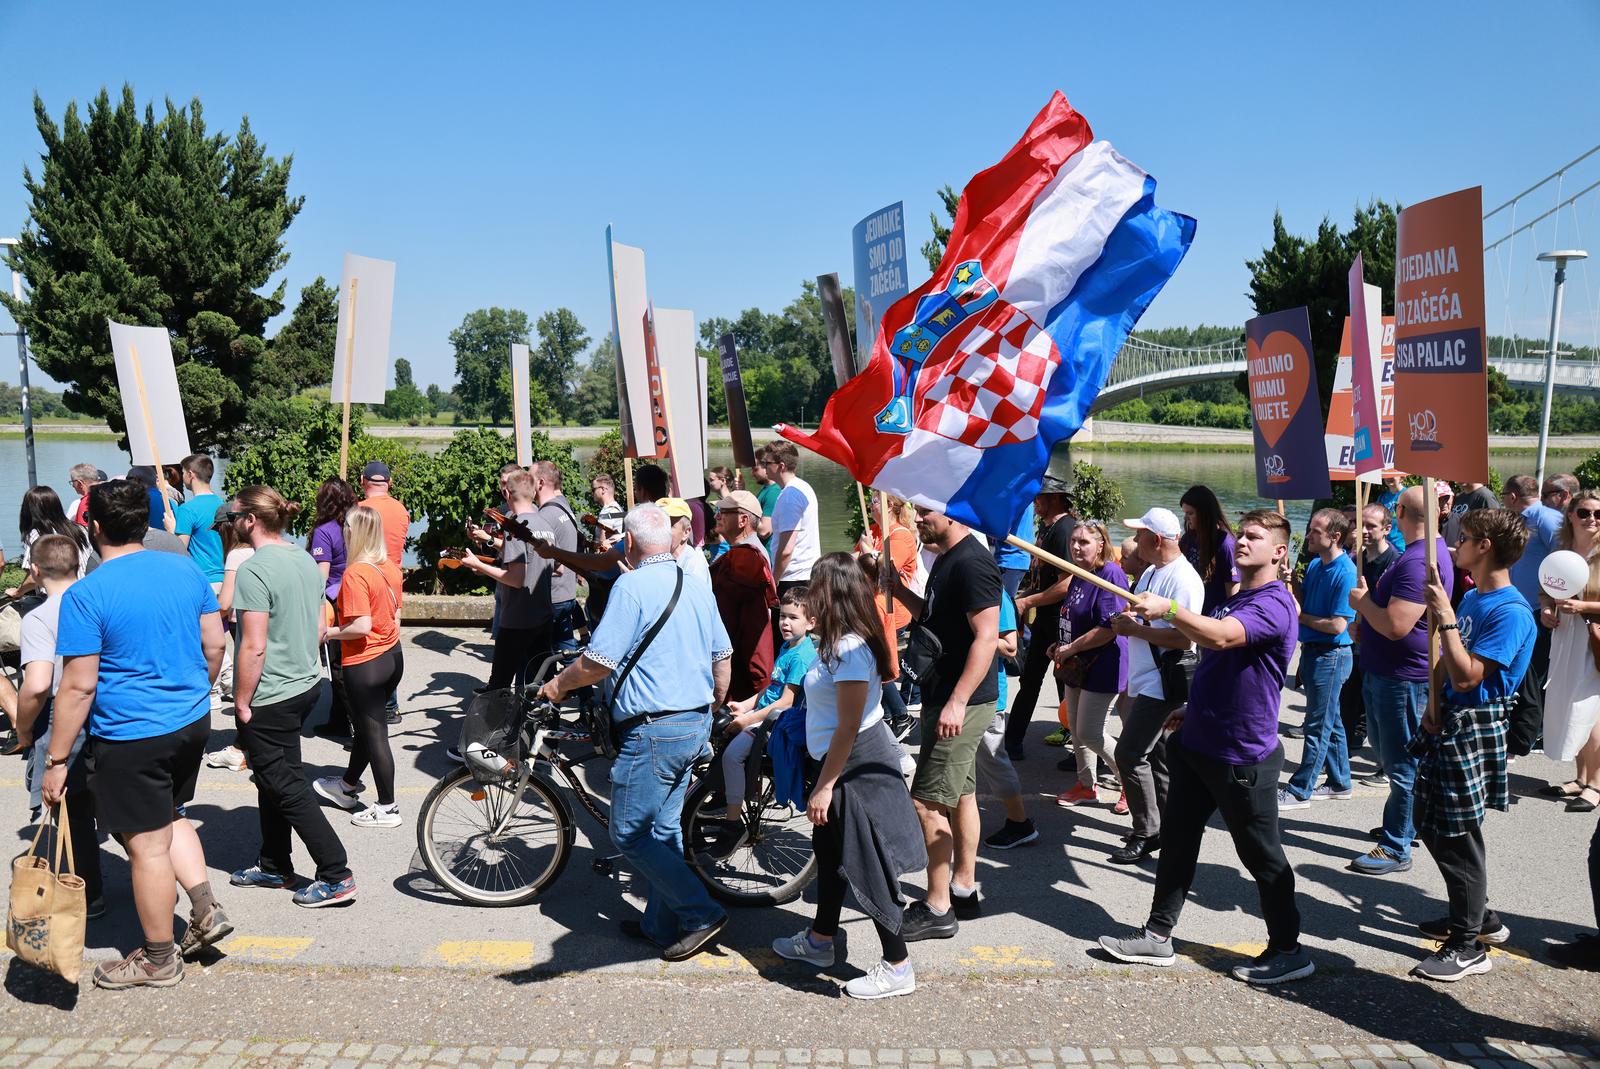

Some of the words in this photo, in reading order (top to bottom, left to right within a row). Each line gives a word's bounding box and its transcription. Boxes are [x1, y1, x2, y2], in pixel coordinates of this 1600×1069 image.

[865, 208, 902, 244] JEDNAKE
[869, 242, 887, 270] SMO
[889, 237, 903, 260] OD
[1407, 288, 1463, 325] ZAČEĆA
[1254, 353, 1294, 376] VOLIMO
[1417, 339, 1467, 368] PALAC
[1256, 378, 1286, 398] MAMU
[1258, 401, 1290, 420] DIJETE
[1408, 410, 1437, 433] HOD
[1263, 454, 1284, 473] HOD
